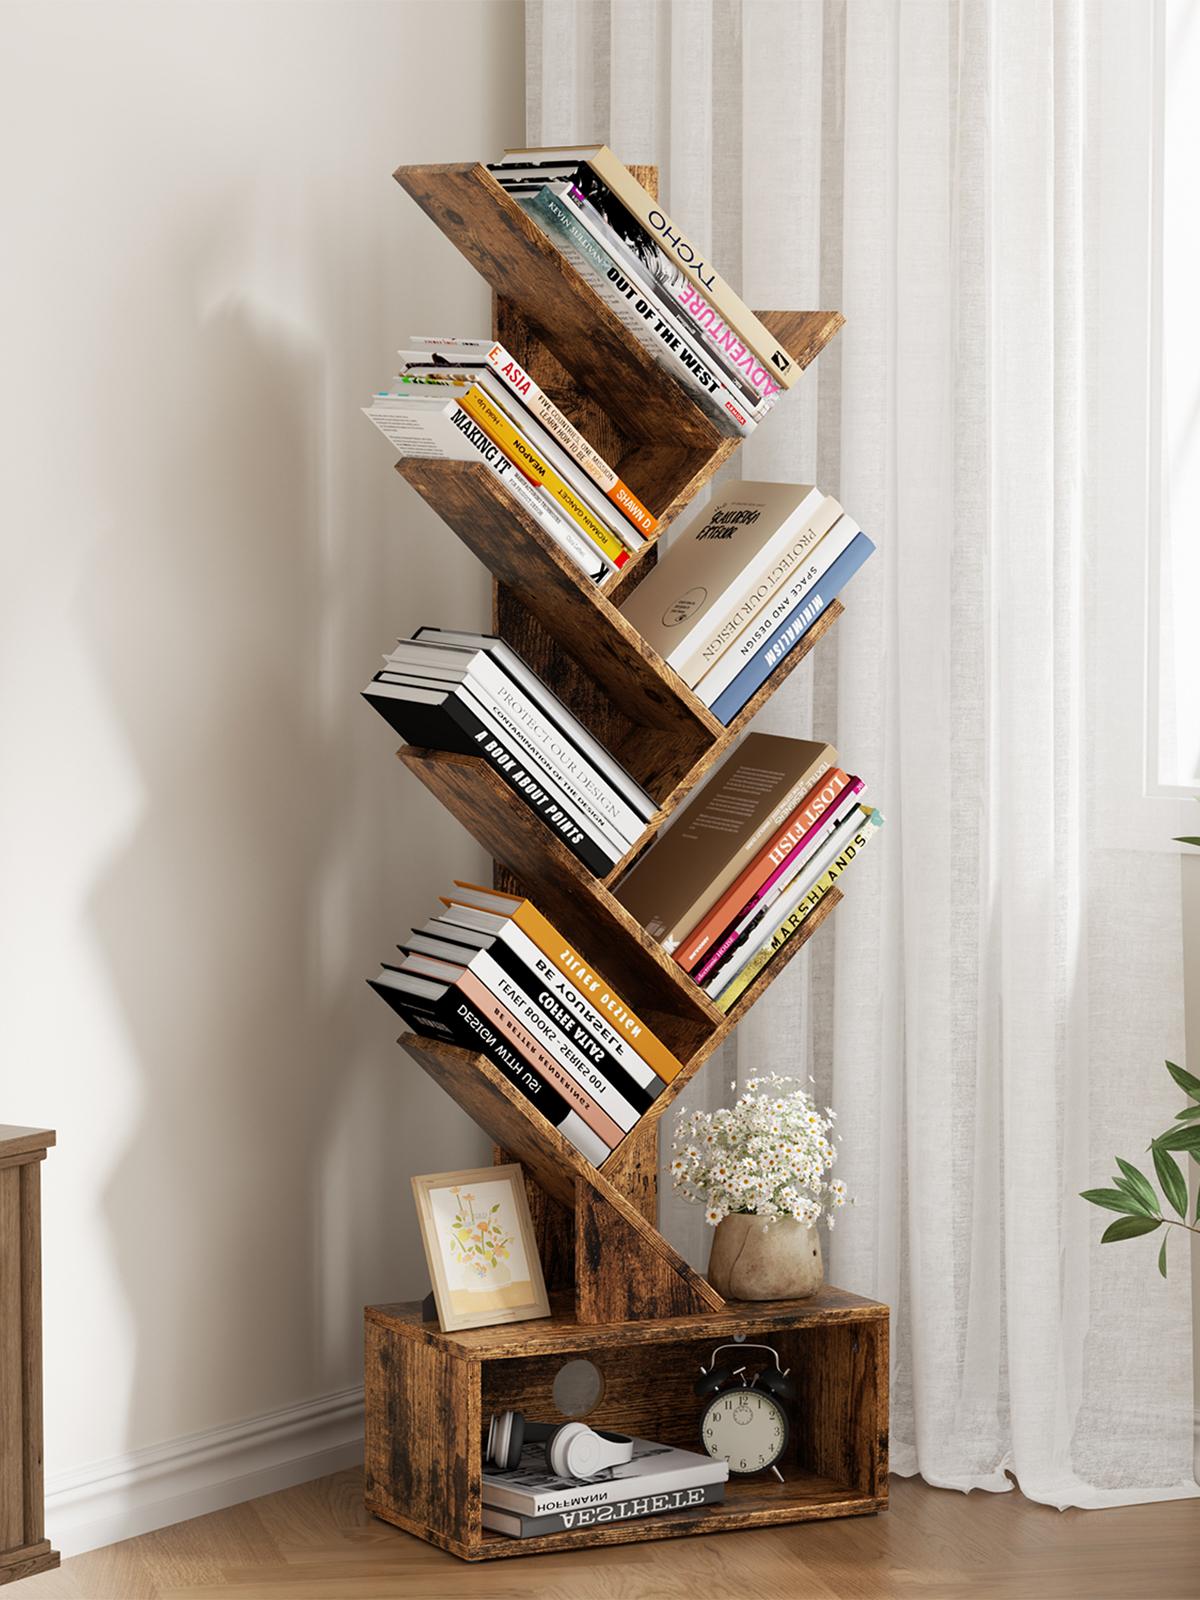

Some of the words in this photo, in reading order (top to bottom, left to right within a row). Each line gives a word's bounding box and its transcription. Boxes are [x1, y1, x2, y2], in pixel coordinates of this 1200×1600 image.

[548, 201, 572, 227] KEVIN
[569, 225, 604, 263] SULLIVAN
[648, 210, 715, 292] TYCHO
[606, 266, 638, 300] OUT
[635, 299, 656, 321] OF
[653, 319, 682, 352] THE
[679, 348, 721, 393] WEST
[678, 281, 780, 398] ADVENTURE
[501, 362, 531, 395] ASIA
[477, 398, 487, 409] Up
[486, 408, 500, 425] Hold
[450, 408, 498, 462] MAKING
[494, 456, 512, 475] IT
[538, 395, 551, 409] FIVE
[580, 442, 593, 455] ONE
[592, 454, 614, 481] MISSION
[540, 409, 558, 431] LEARN
[556, 427, 572, 444] HOW
[569, 442, 579, 453] TO
[576, 448, 586, 462] BE
[513, 439, 546, 477] WEAPON
[558, 488, 584, 517] GANCET
[616, 489, 645, 521] SHAWN
[641, 518, 652, 531] D.
[582, 516, 609, 545] ROMAIN
[767, 528, 817, 588] PROTECT
[741, 584, 769, 614] OUR
[790, 566, 818, 597] SPACE
[772, 598, 790, 619] AND
[702, 612, 744, 661] DESIGN
[741, 619, 772, 655] DESIGN
[764, 594, 824, 667] MINIMALISM
[492, 705, 552, 771] CONTAMINATION
[552, 769, 565, 781] OF
[562, 781, 579, 796] THE
[577, 795, 606, 826] DESIGN
[497, 686, 553, 743] PROTECT
[550, 743, 579, 773] OUR
[577, 771, 620, 818] DESIGN
[474, 730, 489, 743] A
[484, 740, 517, 772] BOOK
[512, 770, 550, 806] ABOUT
[544, 804, 584, 845] POINTS
[805, 776, 846, 825] LOST
[768, 821, 808, 866] FISH
[770, 834, 867, 950] MARSHLANDS
[712, 1412, 721, 1422] 10
[724, 1400, 732, 1410] 11
[739, 1396, 748, 1406] 12
[768, 1411, 776, 1420] 2
[706, 1428, 713, 1438] 9
[711, 1444, 718, 1454] 8
[768, 1443, 774, 1453] 4
[773, 1427, 780, 1436] 3
[739, 1459, 747, 1469] 6
[758, 1454, 765, 1464] 5
